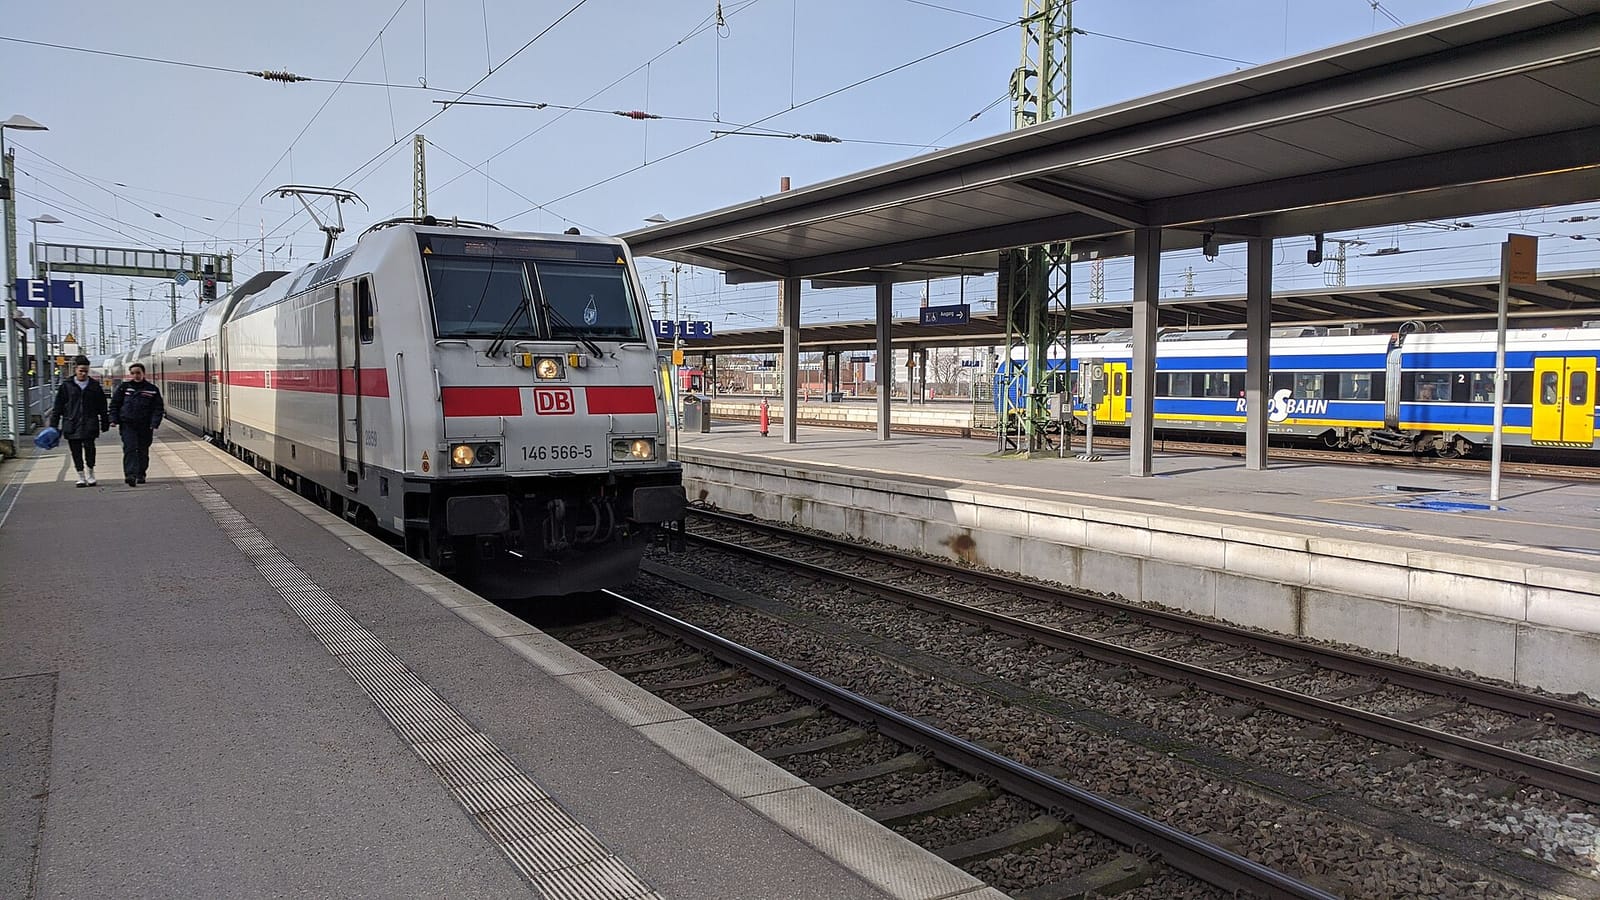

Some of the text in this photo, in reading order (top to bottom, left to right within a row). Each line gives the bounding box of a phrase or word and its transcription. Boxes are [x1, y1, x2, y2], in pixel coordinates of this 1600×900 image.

[28, 279, 80, 302] E 1
[660, 320, 669, 334] E
[686, 321, 711, 335] E 3
[1458, 374, 1465, 383] 2
[538, 391, 570, 411] DB
[521, 444, 593, 461] 146 566-5
